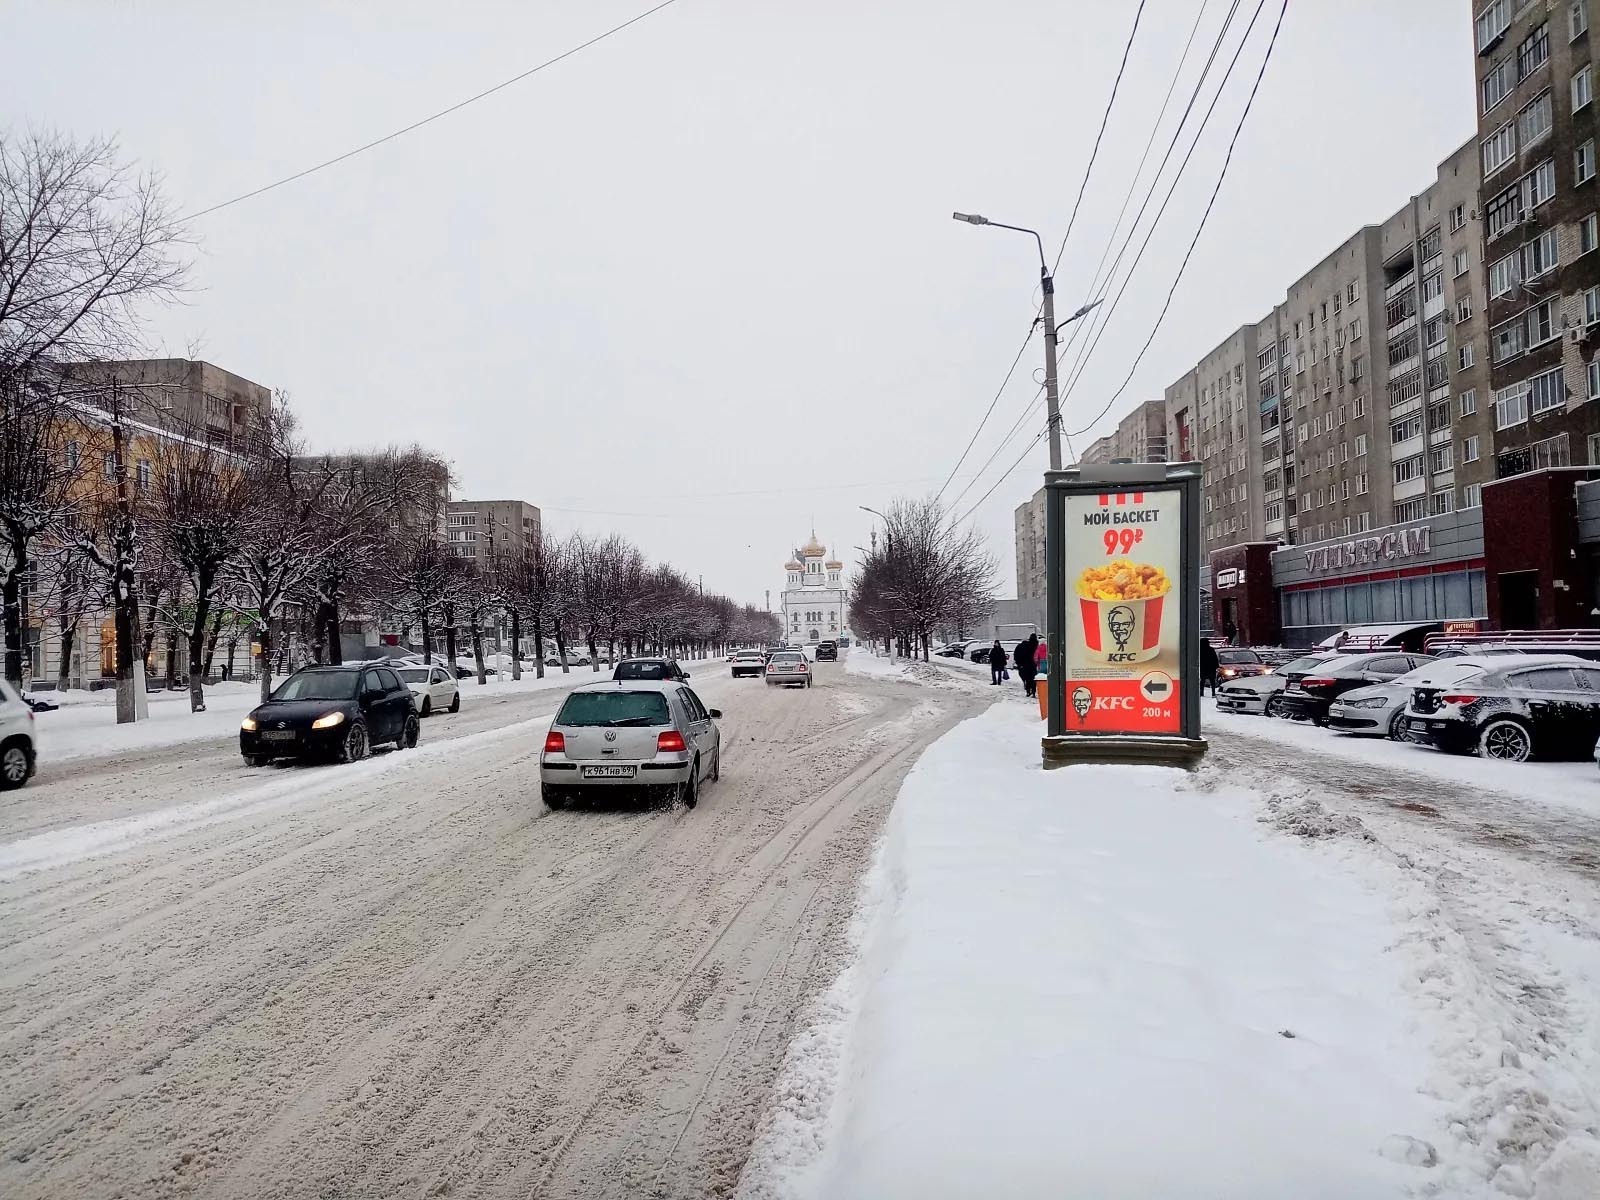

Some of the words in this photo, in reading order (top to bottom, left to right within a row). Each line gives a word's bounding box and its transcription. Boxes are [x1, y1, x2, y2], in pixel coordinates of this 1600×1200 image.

[1084, 509, 1110, 525] МОЙ
[1113, 510, 1160, 524] БАСКЕТ
[1304, 526, 1430, 573] УНИВЕРСАМ
[1107, 652, 1137, 662] KFC
[1093, 697, 1135, 710] KFC
[1142, 707, 1161, 718] 200
